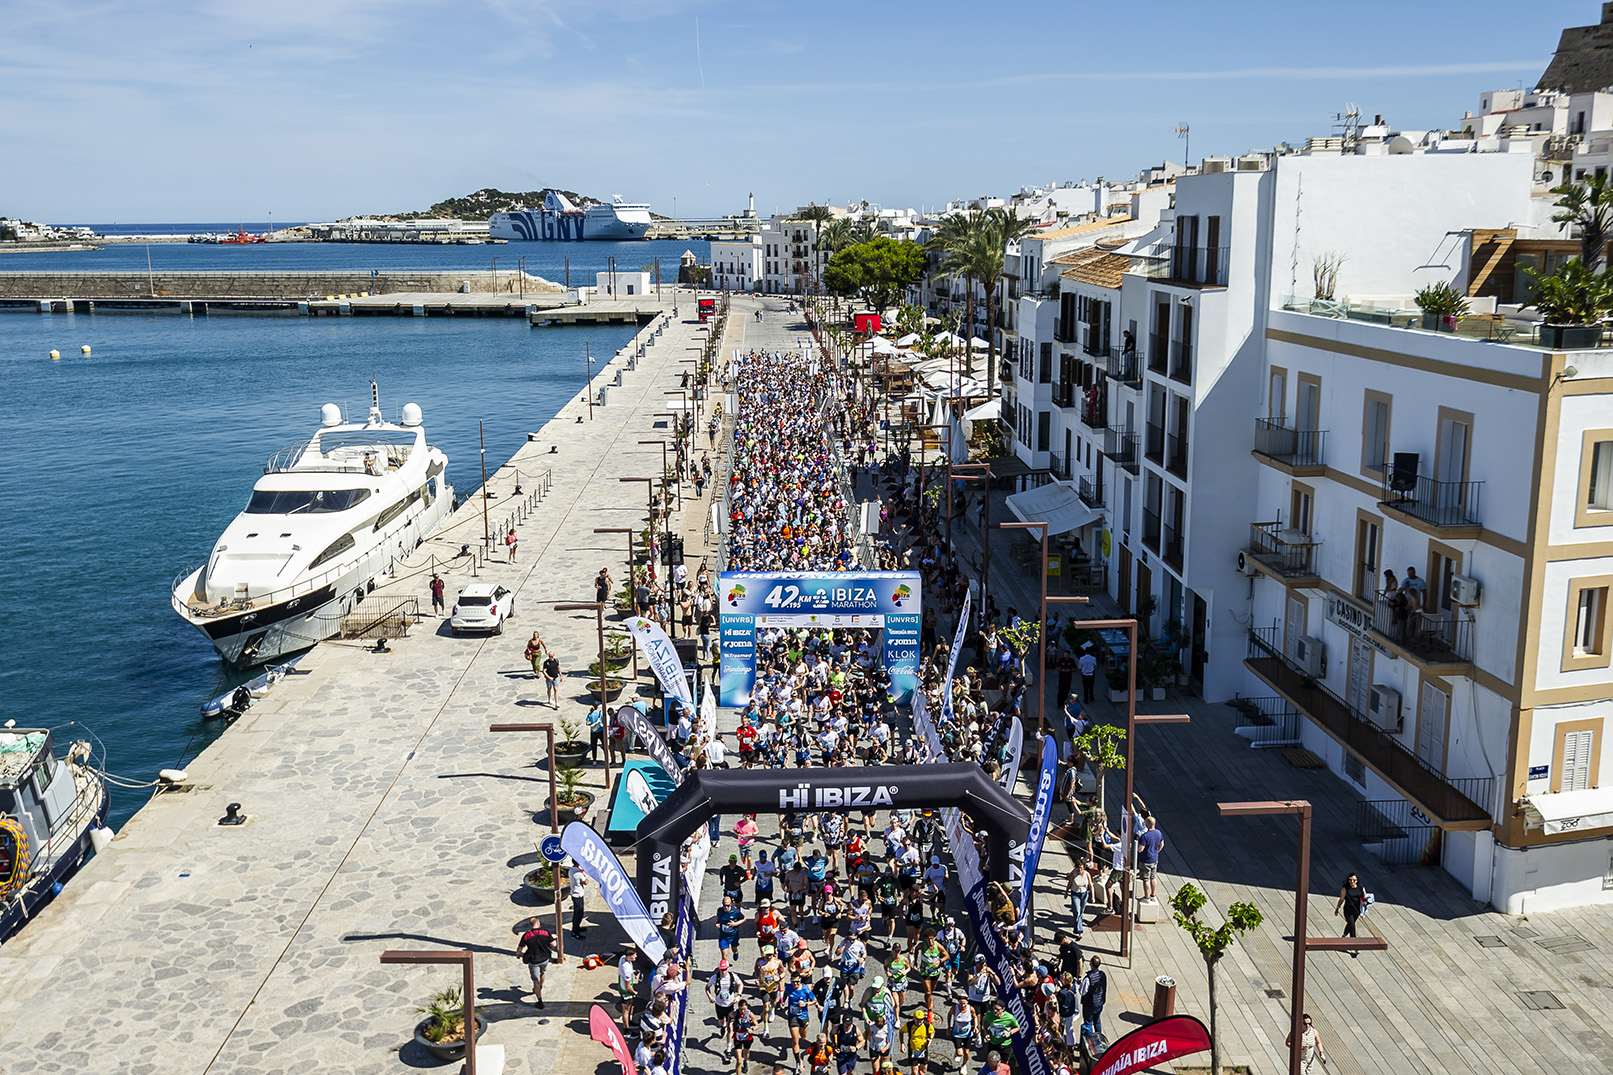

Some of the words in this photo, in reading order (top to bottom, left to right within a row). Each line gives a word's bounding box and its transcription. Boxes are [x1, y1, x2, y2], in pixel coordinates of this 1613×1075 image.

[541, 211, 585, 241] GNV
[831, 588, 877, 601] IBIZA
[722, 616, 753, 624] [UNVRS]
[887, 615, 919, 624] [UNVRS]
[1336, 599, 1363, 627] CASINO
[887, 650, 916, 659] KLOK
[779, 783, 811, 808] HÏ
[1133, 1039, 1168, 1064] IBIZA
